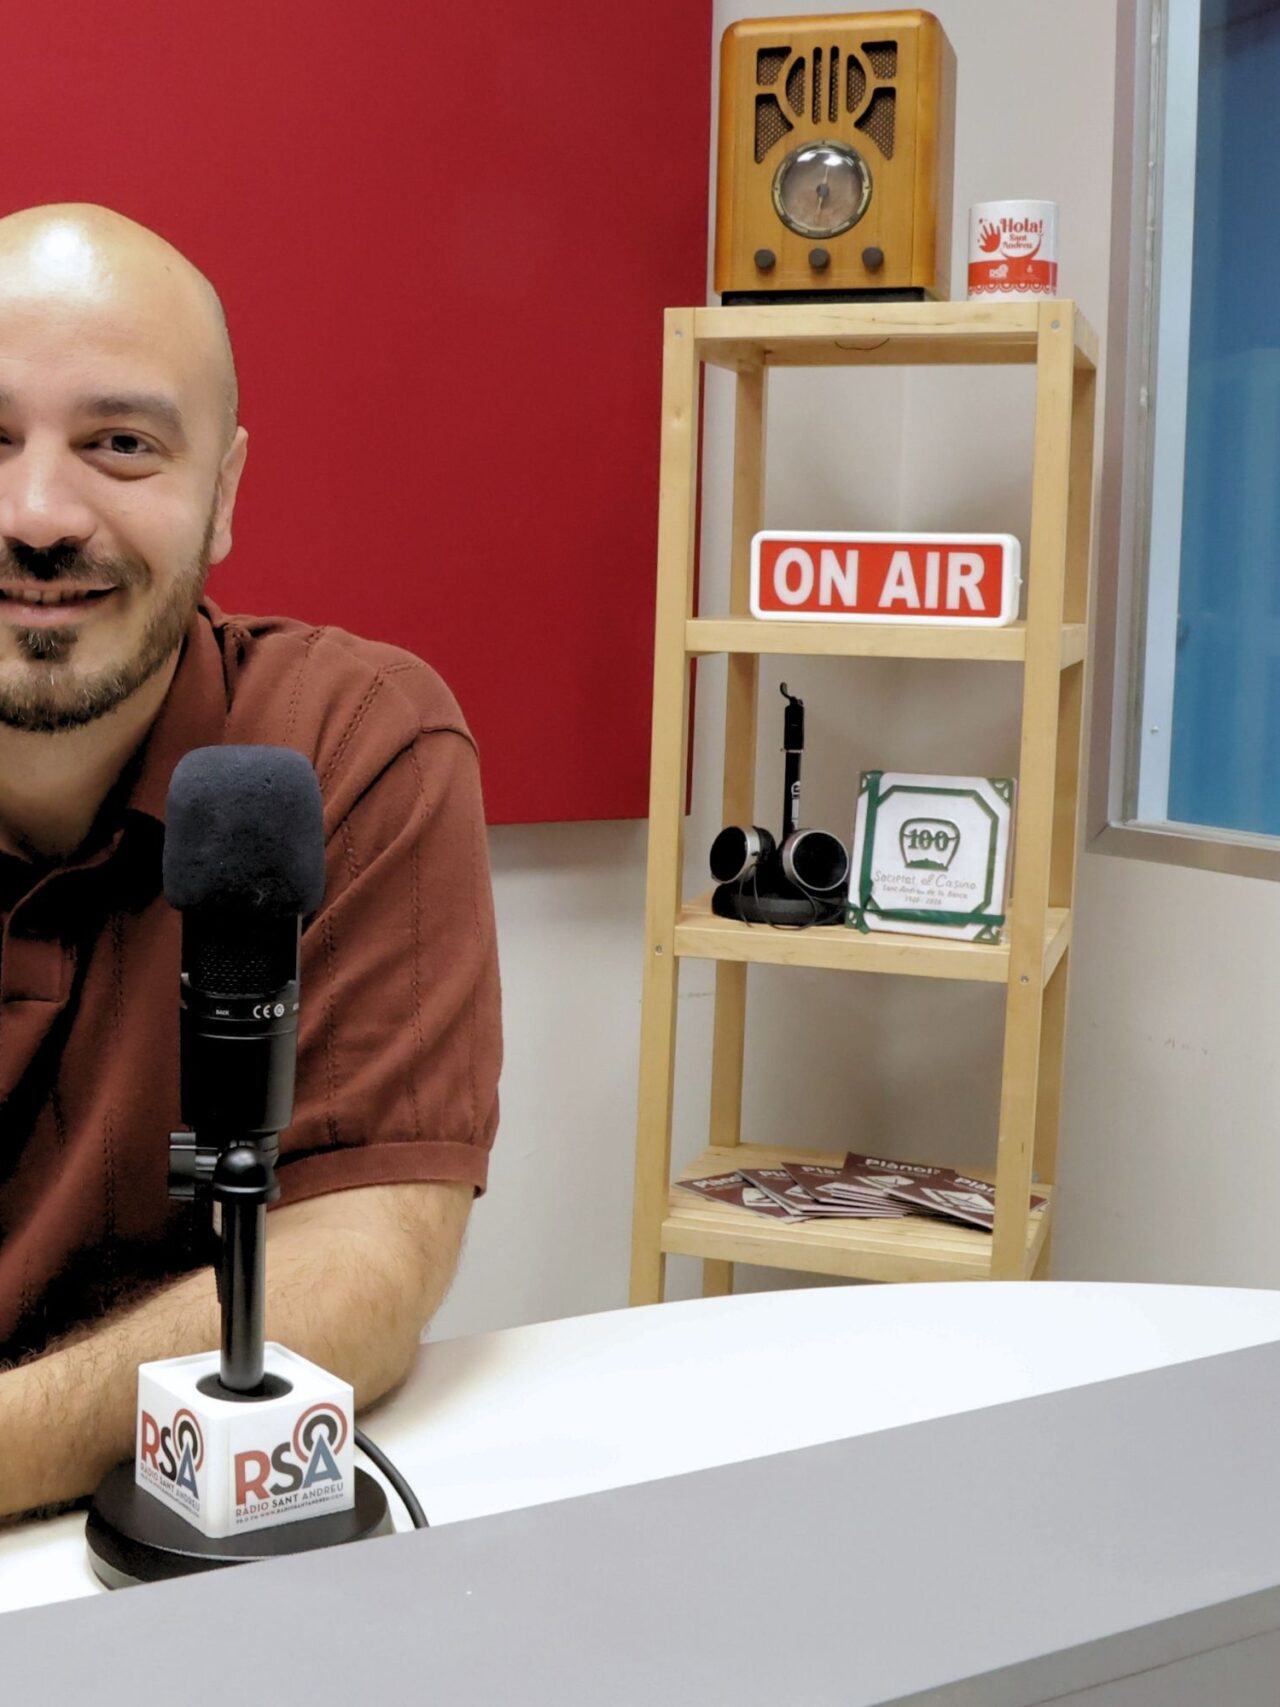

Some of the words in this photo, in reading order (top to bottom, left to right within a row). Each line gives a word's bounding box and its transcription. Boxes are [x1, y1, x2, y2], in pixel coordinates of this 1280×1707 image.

[1000, 218, 1043, 233] Hola!
[772, 547, 859, 607] ON
[878, 550, 986, 611] AIR
[908, 828, 950, 852] 100
[936, 874, 977, 890] Casino
[141, 1409, 200, 1500] RSA
[234, 1433, 343, 1506] RSA
[272, 1494, 299, 1508] SANT
[302, 1482, 344, 1501] ANDREU
